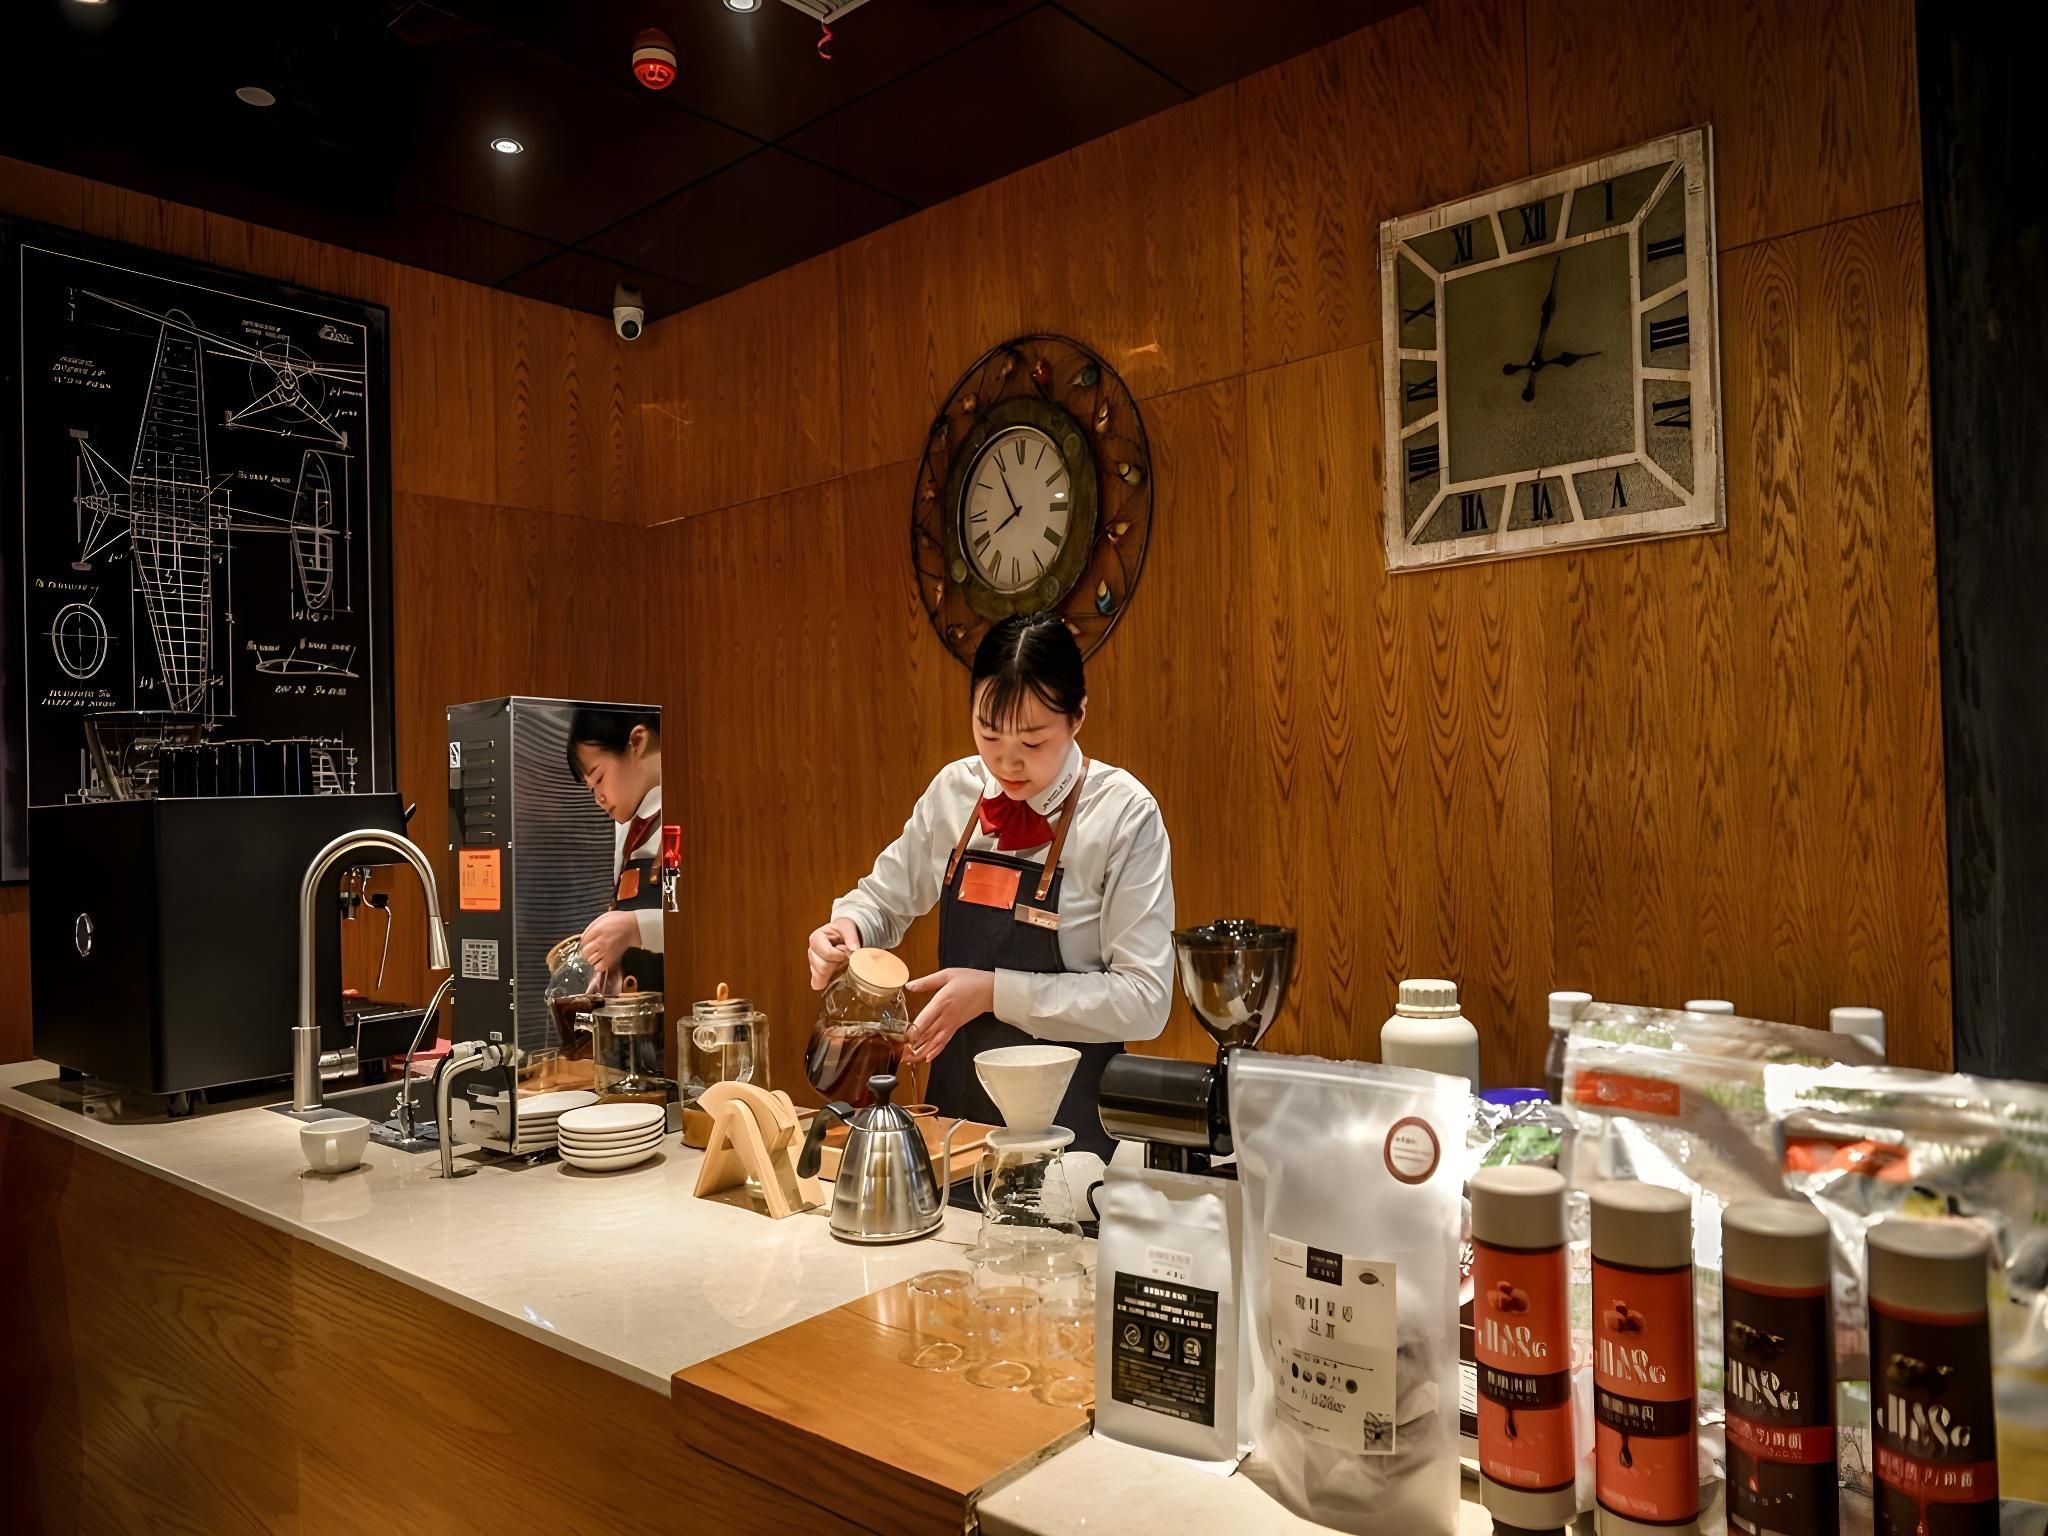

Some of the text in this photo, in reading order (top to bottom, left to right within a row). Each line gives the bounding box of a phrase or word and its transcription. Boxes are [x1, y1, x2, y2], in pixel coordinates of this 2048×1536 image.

[1604, 181, 1615, 222] I
[1520, 201, 1547, 247] XII
[1452, 224, 1473, 266] XI
[1647, 232, 1685, 262] II
[1403, 298, 1437, 326] X
[1649, 314, 1690, 353] III
[1406, 376, 1438, 402] IX
[1652, 395, 1691, 431] IV
[1530, 482, 1554, 522] VI
[1610, 469, 1628, 509] V
[1460, 491, 1489, 533] VII
